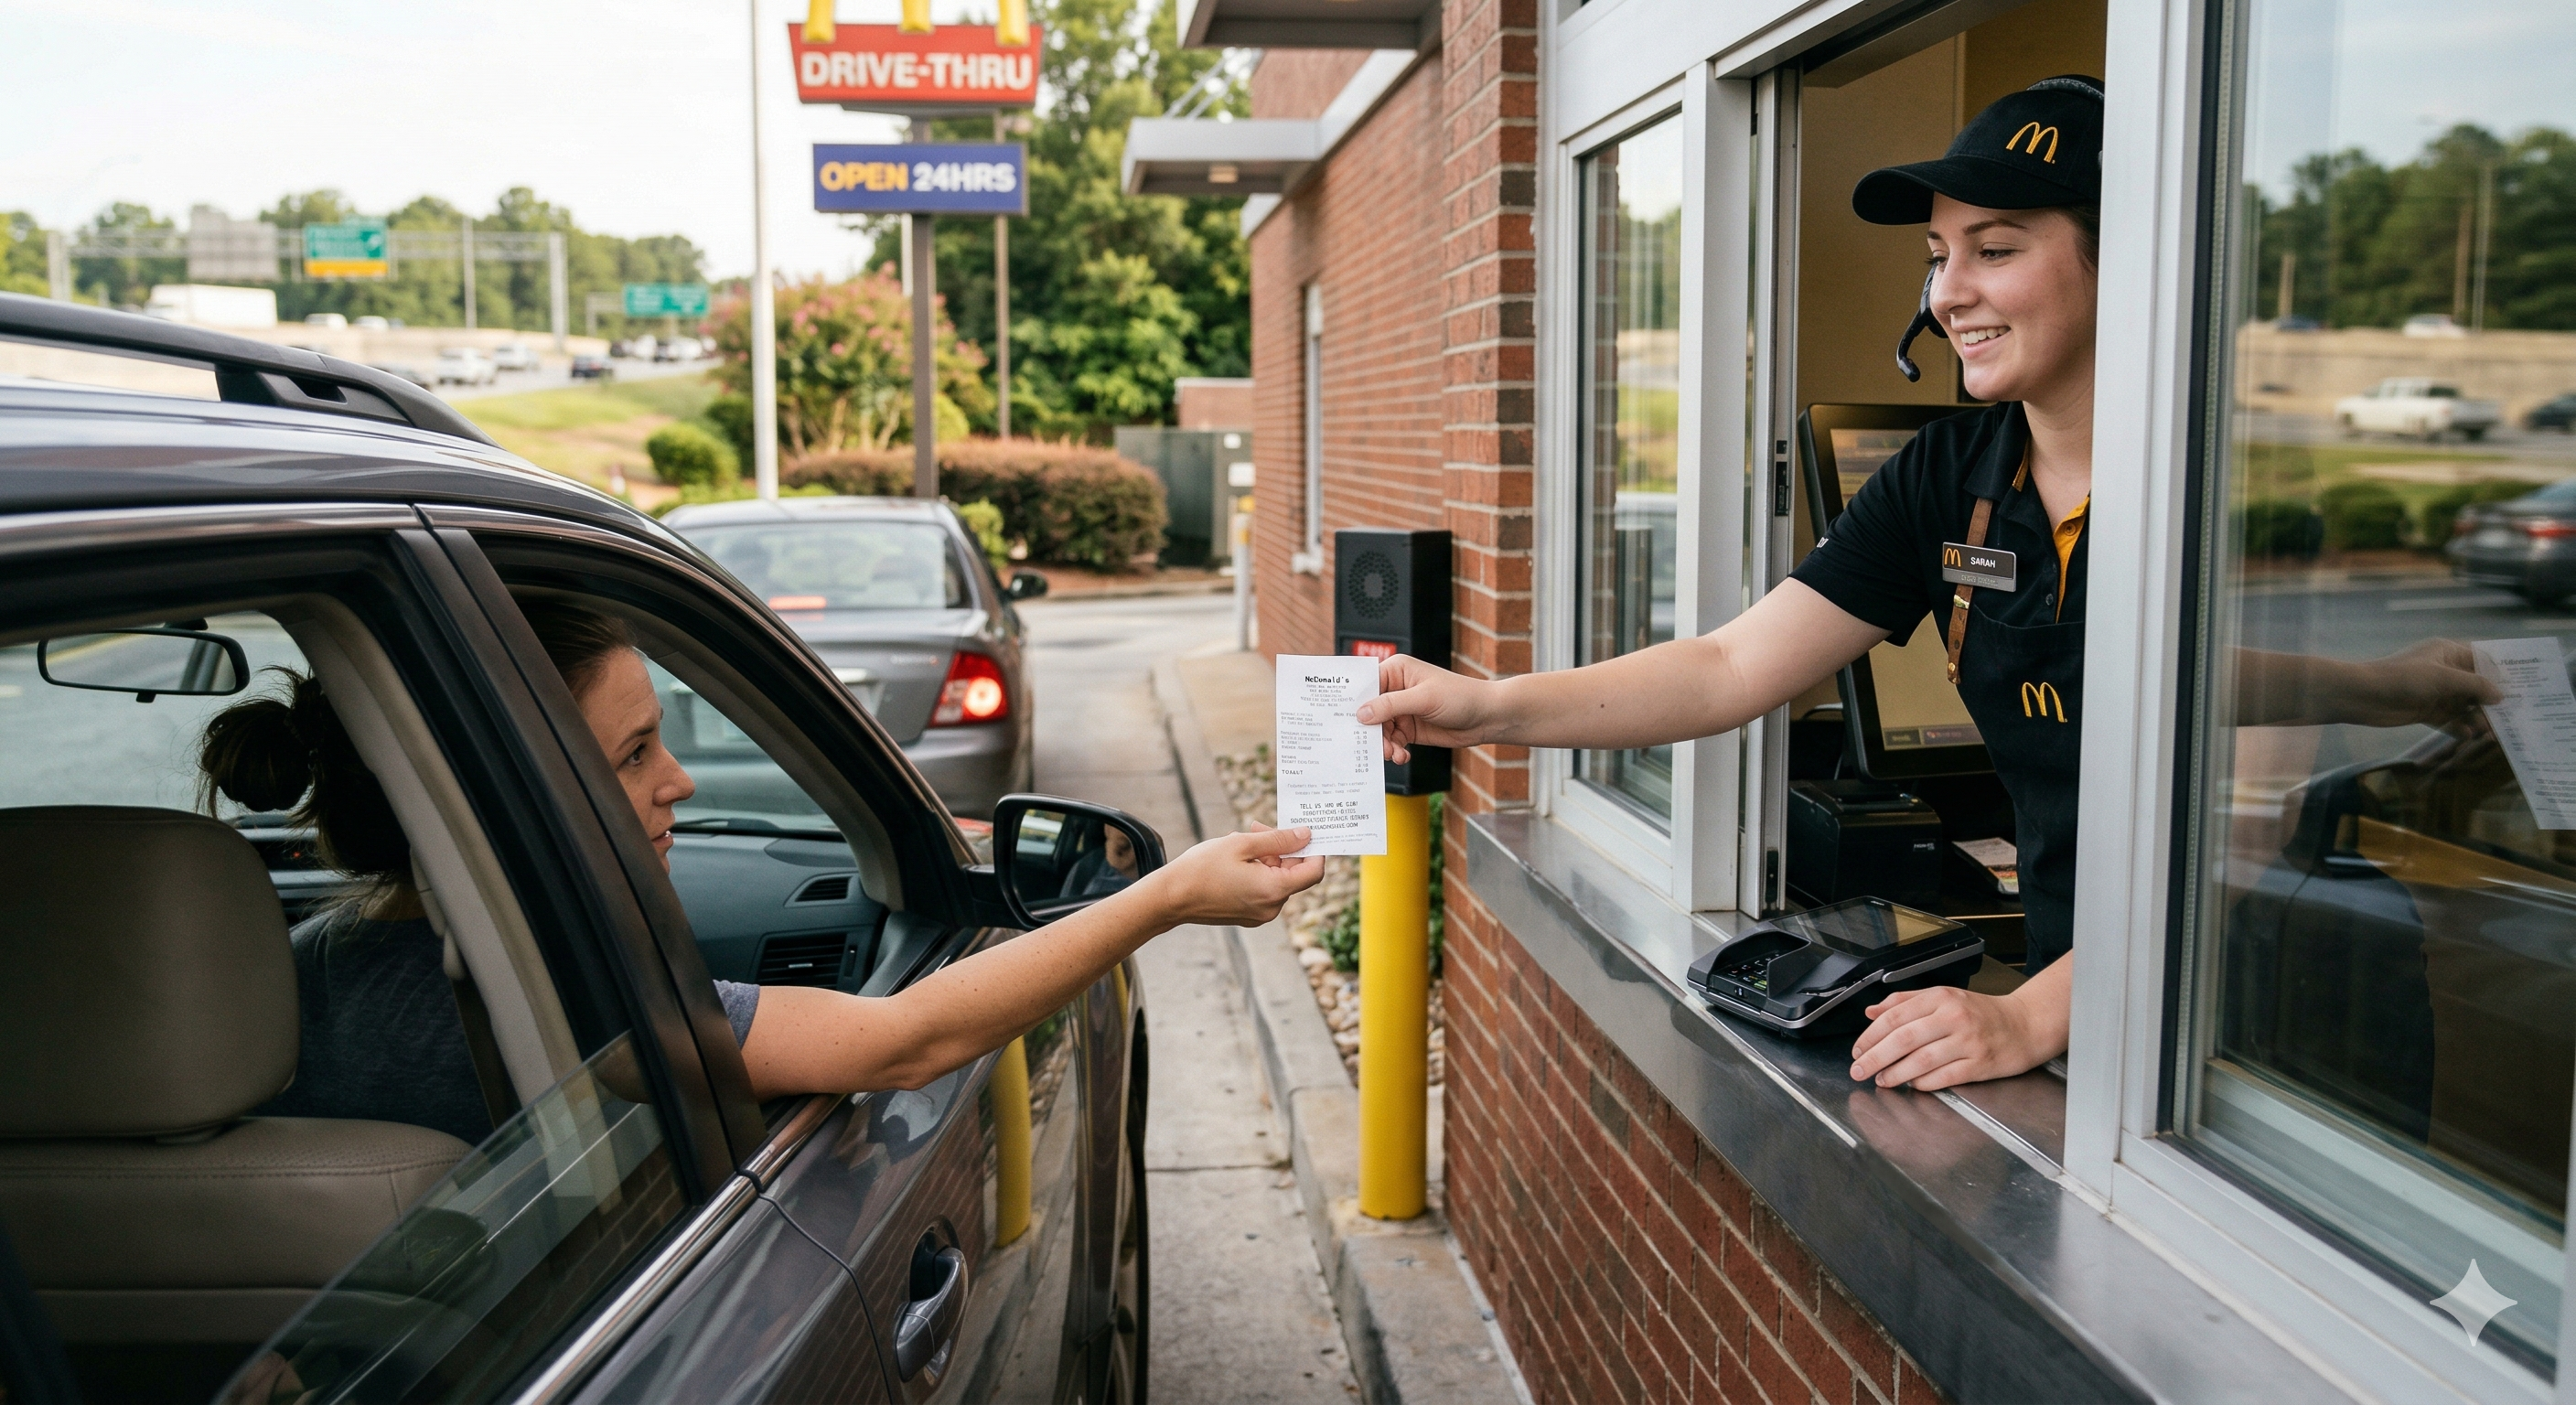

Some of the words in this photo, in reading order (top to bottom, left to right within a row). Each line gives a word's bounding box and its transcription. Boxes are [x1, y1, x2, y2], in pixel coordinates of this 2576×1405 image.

[800, 51, 1033, 90] DRIVE-THRU
[820, 161, 908, 191] OPEN
[912, 162, 1016, 192] 24HRS
[1970, 556, 1996, 568] SARAH
